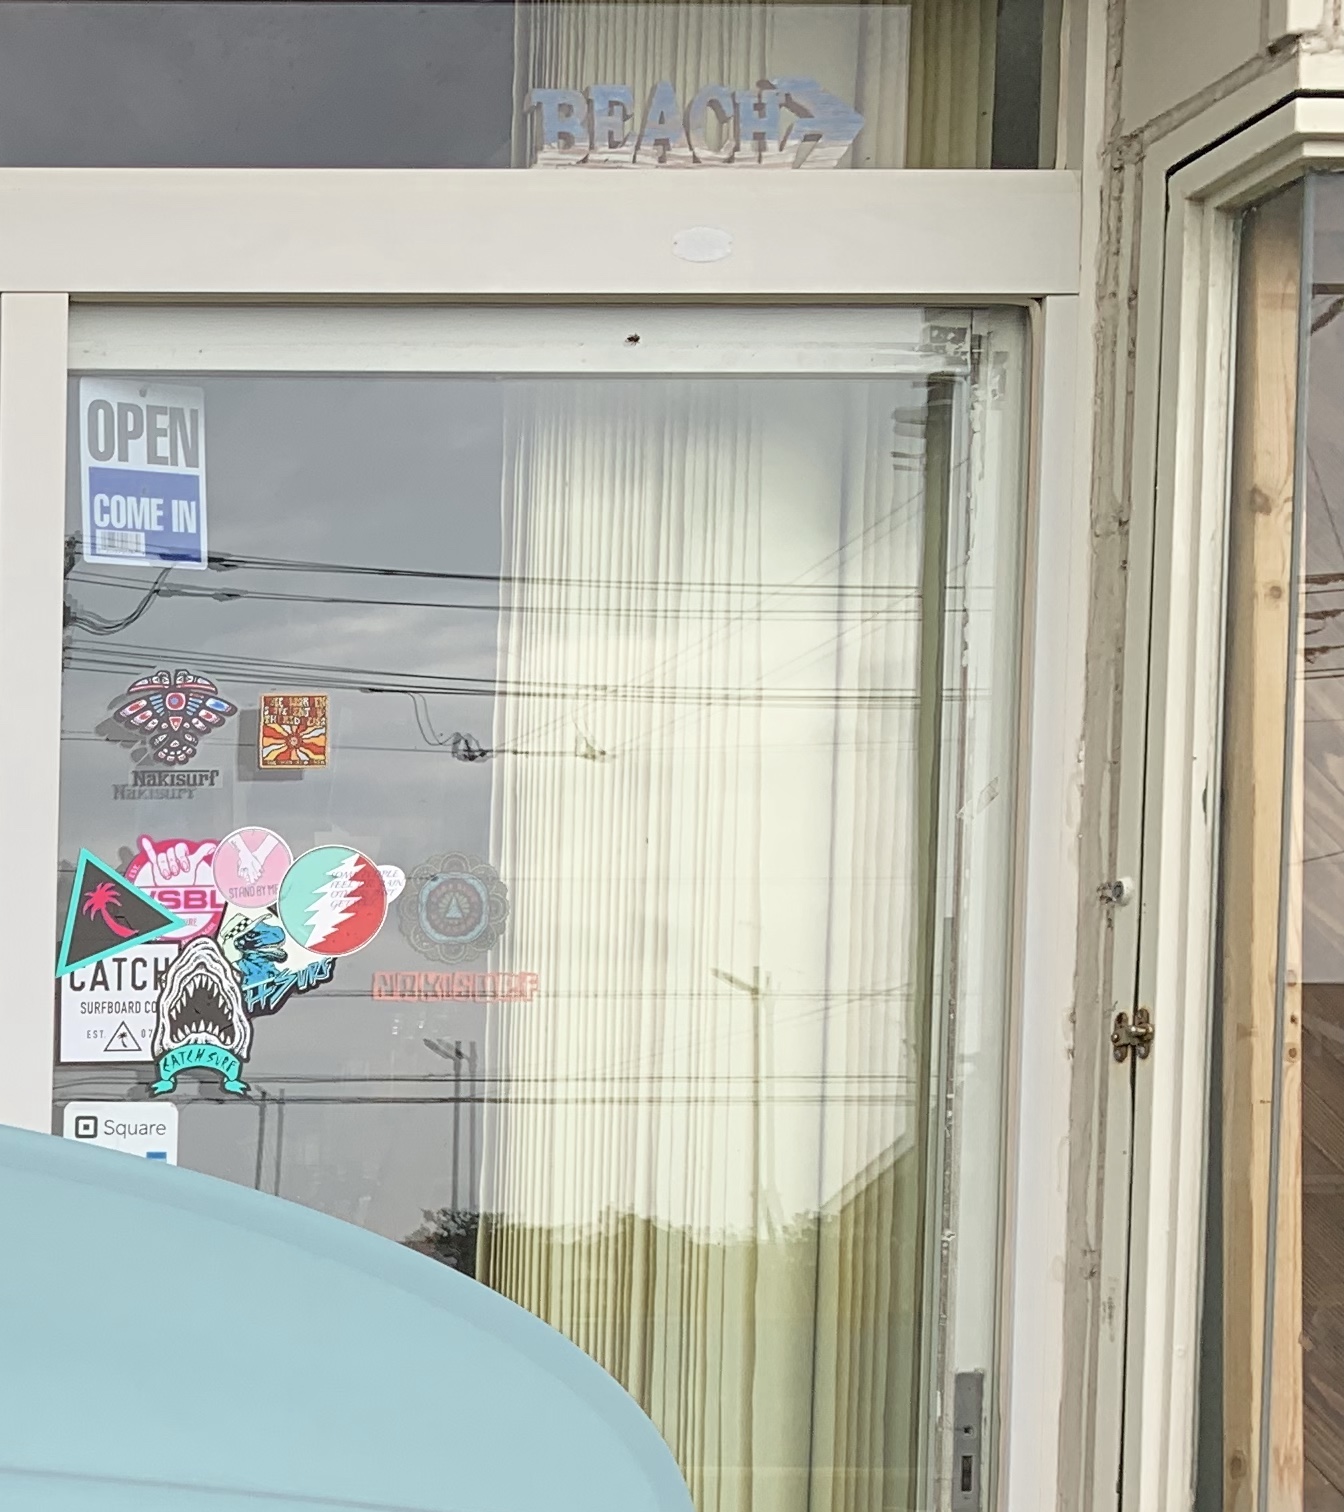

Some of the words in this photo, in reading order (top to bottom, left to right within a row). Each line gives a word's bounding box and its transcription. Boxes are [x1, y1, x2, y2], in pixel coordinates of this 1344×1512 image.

[526, 79, 784, 168] BEACH
[87, 399, 199, 468] OPEN
[93, 493, 164, 531] COME
[171, 499, 197, 533] IN
[228, 887, 256, 899] STAND
[256, 885, 267, 896] BY
[80, 1001, 141, 1014] SURFBOARD
[162, 1048, 205, 1073] CATCH
[206, 1051, 238, 1074] SURF
[103, 1119, 167, 1139] Square
